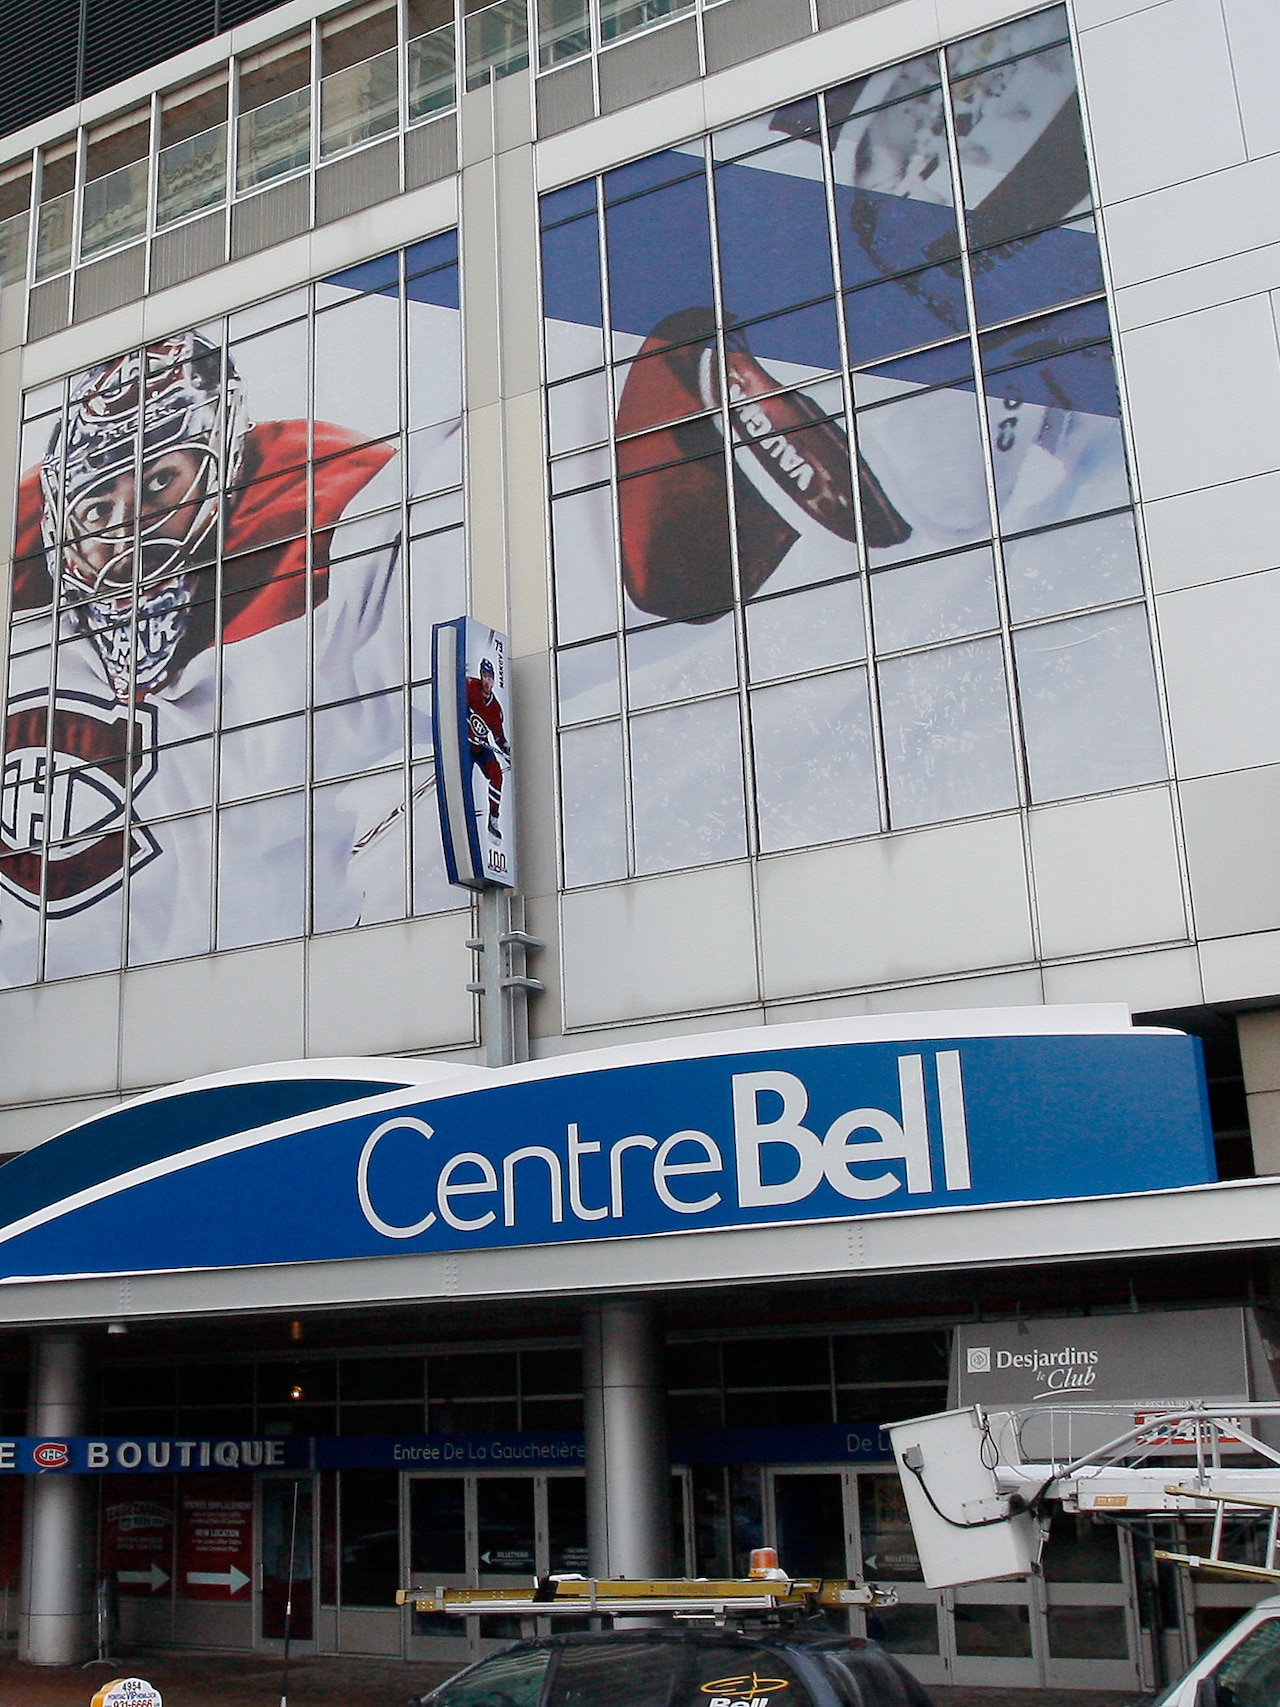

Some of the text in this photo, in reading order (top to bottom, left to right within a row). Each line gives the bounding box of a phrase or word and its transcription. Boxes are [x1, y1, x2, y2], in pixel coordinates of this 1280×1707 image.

[488, 849, 506, 868] 100
[357, 1049, 971, 1240] Centre Bell
[996, 1347, 1098, 1372] Desjardins
[1047, 1364, 1096, 1389] Club
[393, 1441, 586, 1460] Entrée De La Gauchetière
[847, 1433, 893, 1452] De L
[87, 1440, 285, 1469] BOUTIQUE
[122, 1681, 141, 1691] 4954
